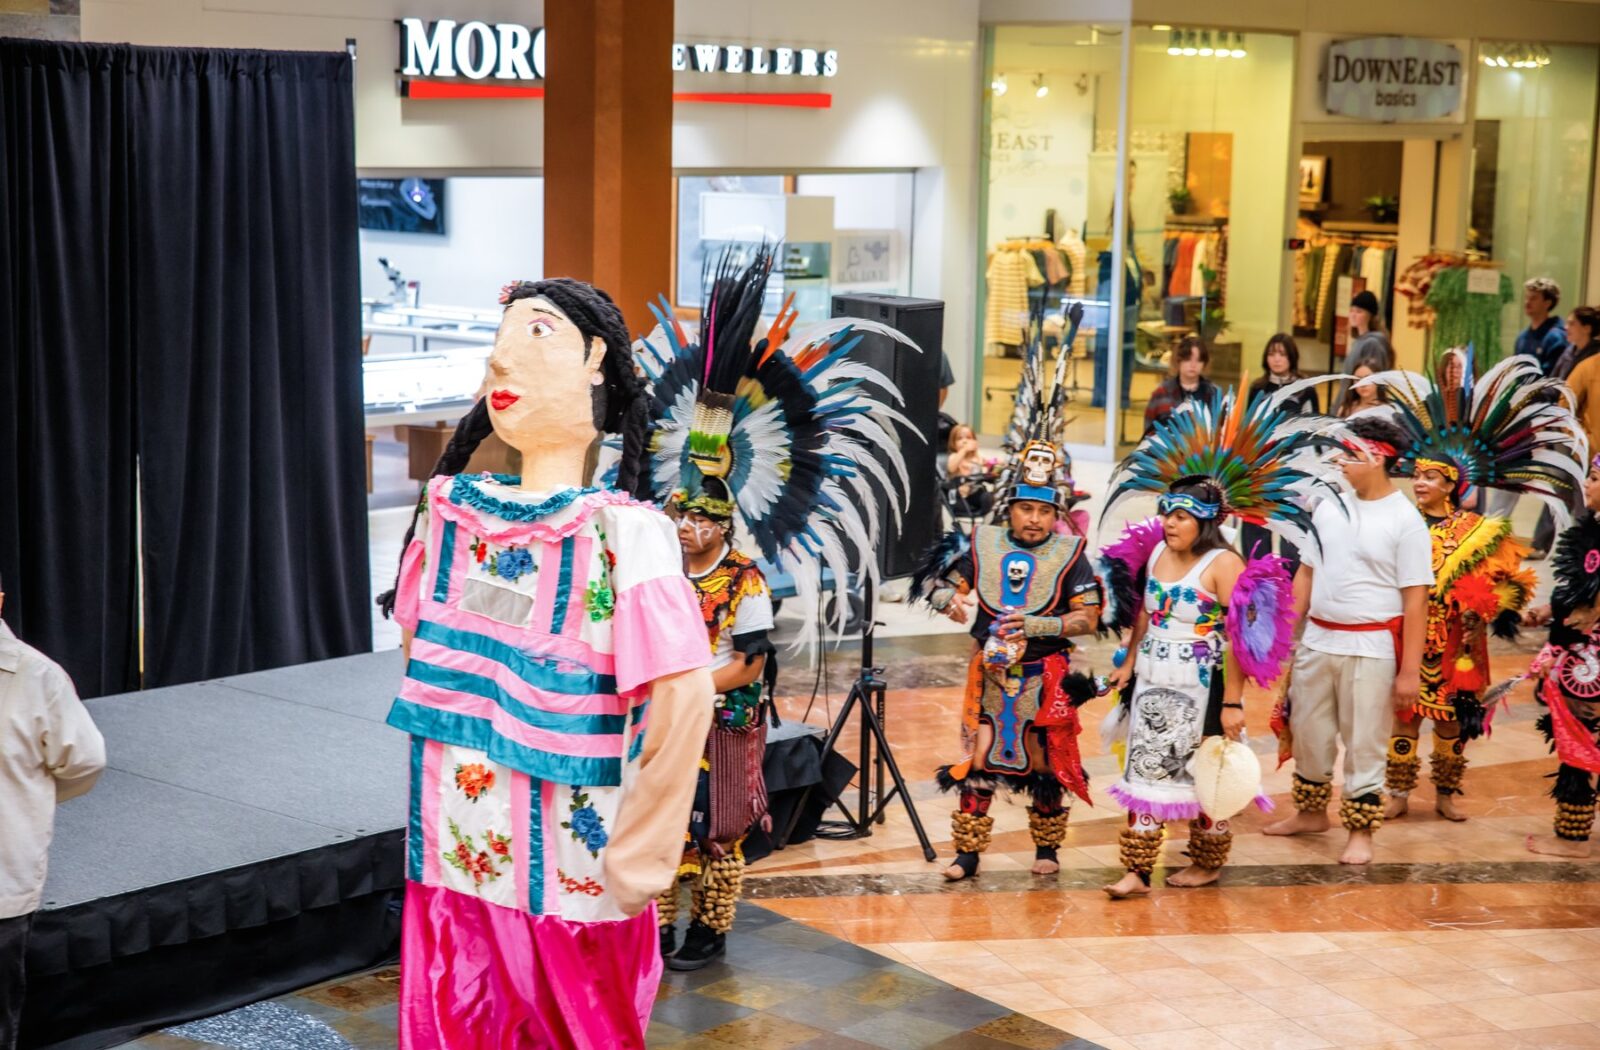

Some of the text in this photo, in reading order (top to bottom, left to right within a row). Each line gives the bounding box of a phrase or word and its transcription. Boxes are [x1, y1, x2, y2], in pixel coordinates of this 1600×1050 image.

[672, 43, 838, 77] EWELERS
[1375, 89, 1416, 107] basics
[993, 131, 1054, 152] EAST
